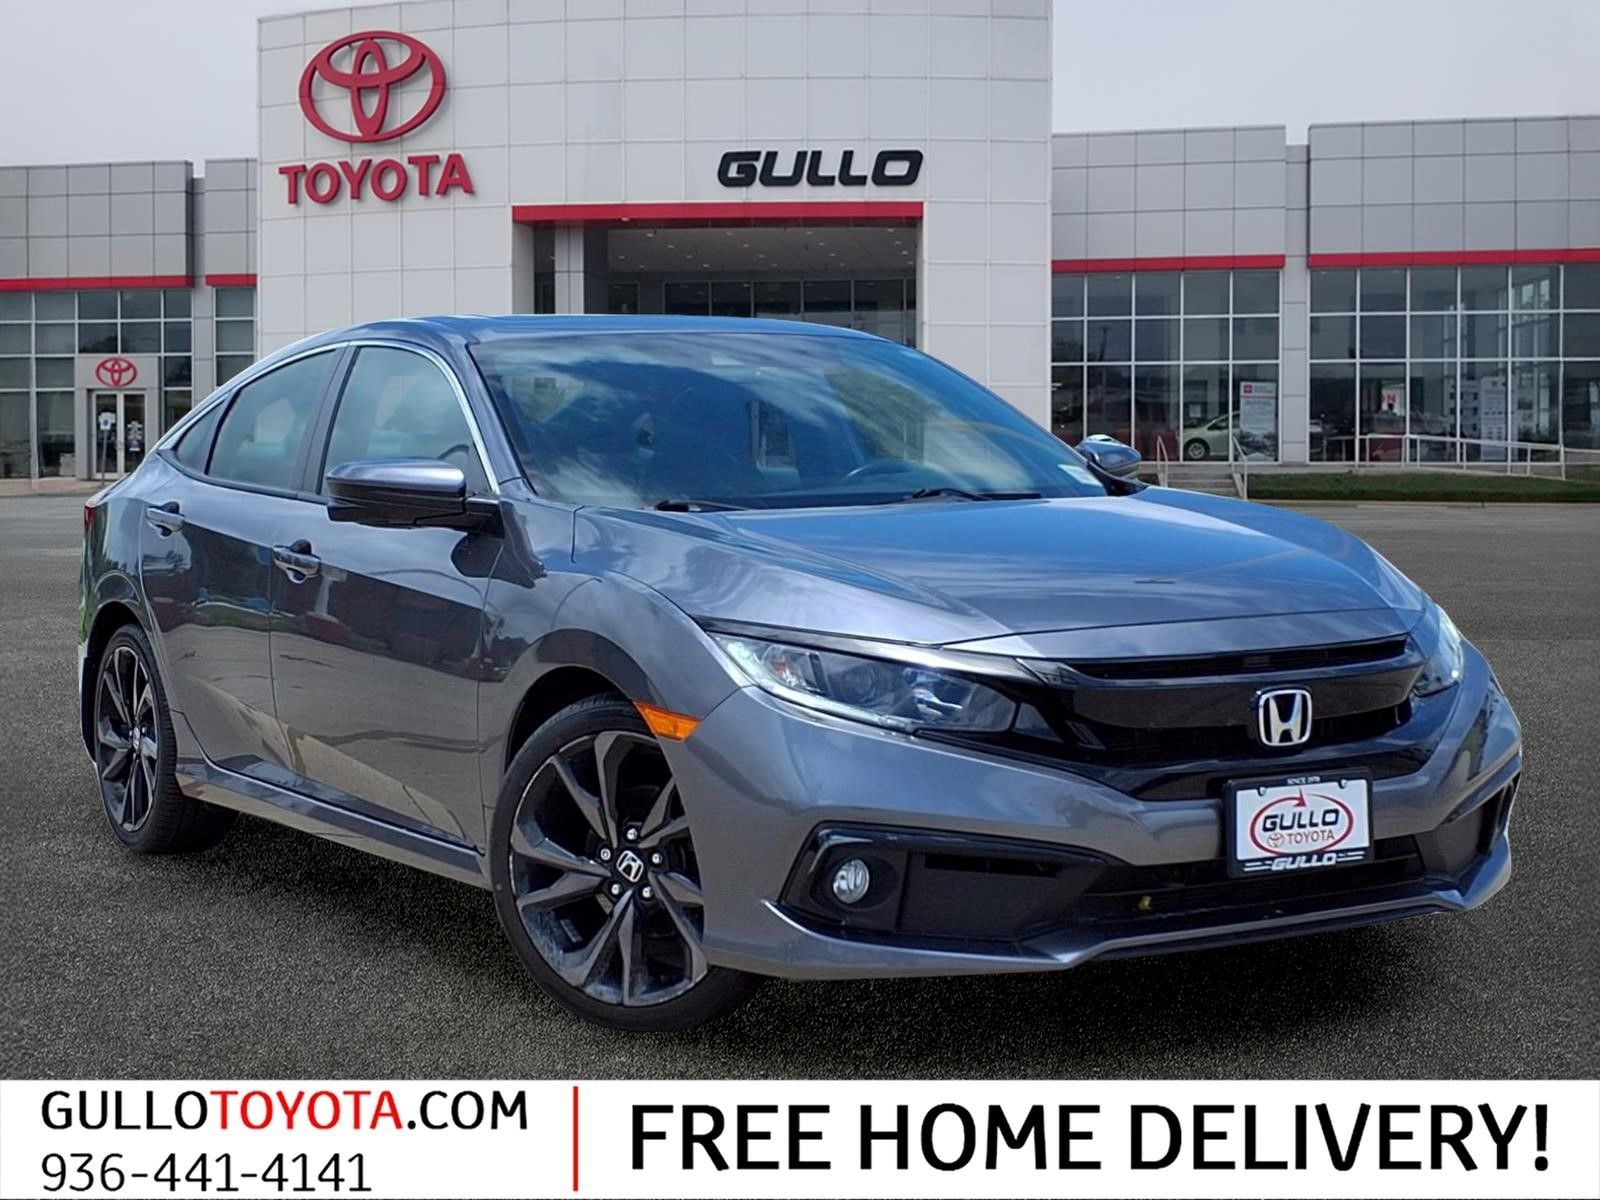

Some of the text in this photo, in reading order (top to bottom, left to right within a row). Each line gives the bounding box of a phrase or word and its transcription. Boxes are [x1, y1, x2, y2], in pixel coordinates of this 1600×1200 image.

[279, 153, 475, 204] TOYOTA
[717, 149, 924, 188] GULLO
[1262, 808, 1340, 832] GULLO
[1287, 829, 1335, 845] TOYOTA
[1271, 853, 1337, 871] GULLO
